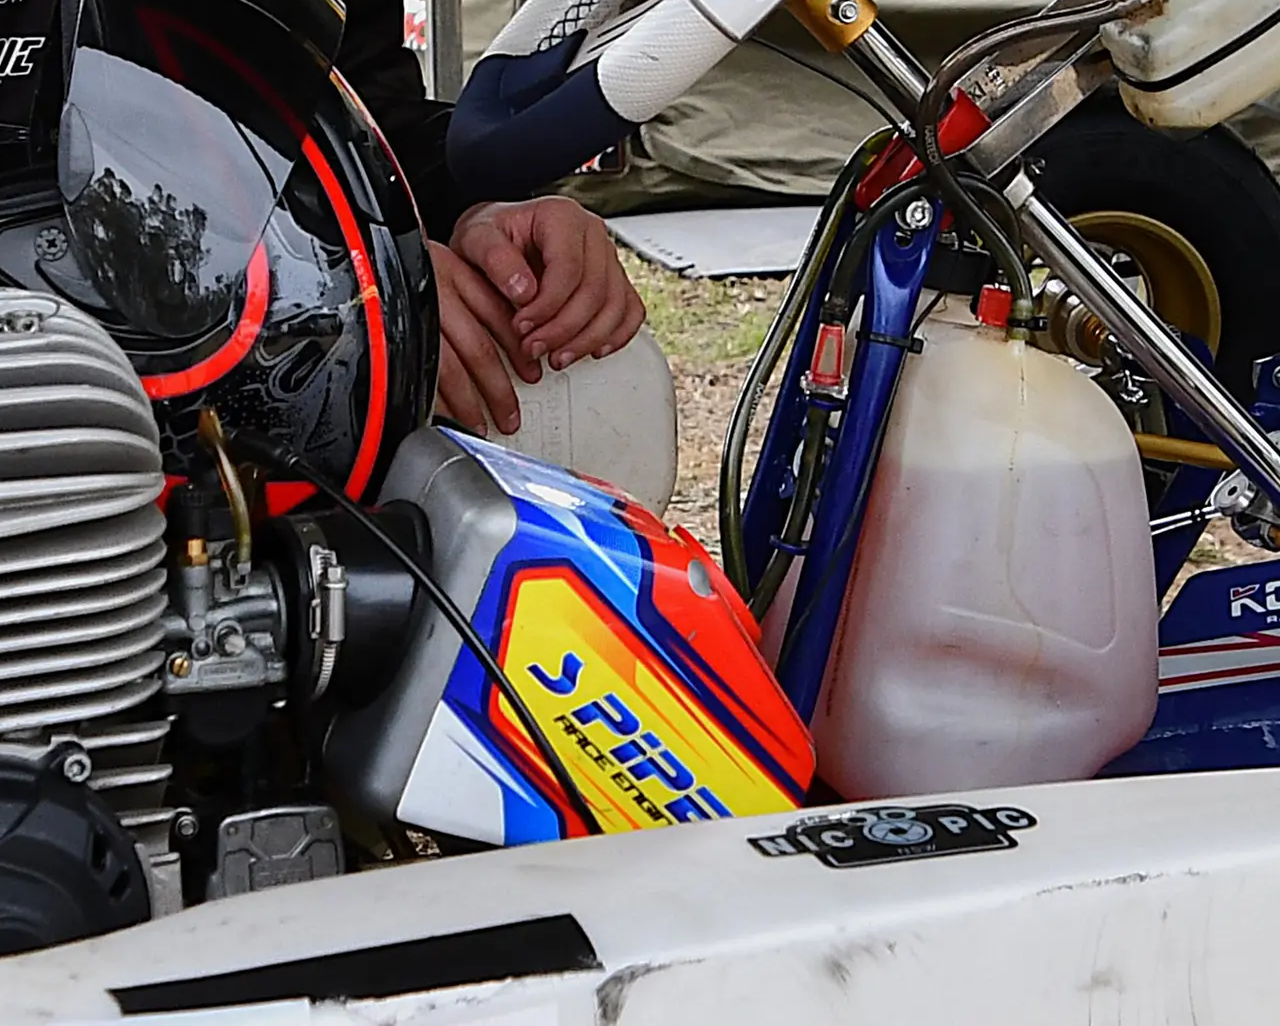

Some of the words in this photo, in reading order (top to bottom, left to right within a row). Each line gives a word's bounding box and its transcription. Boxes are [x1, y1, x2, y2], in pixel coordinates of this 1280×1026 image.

[554, 714, 616, 773] RACE
[757, 829, 854, 856] NIC
[937, 808, 1030, 835] PIC
